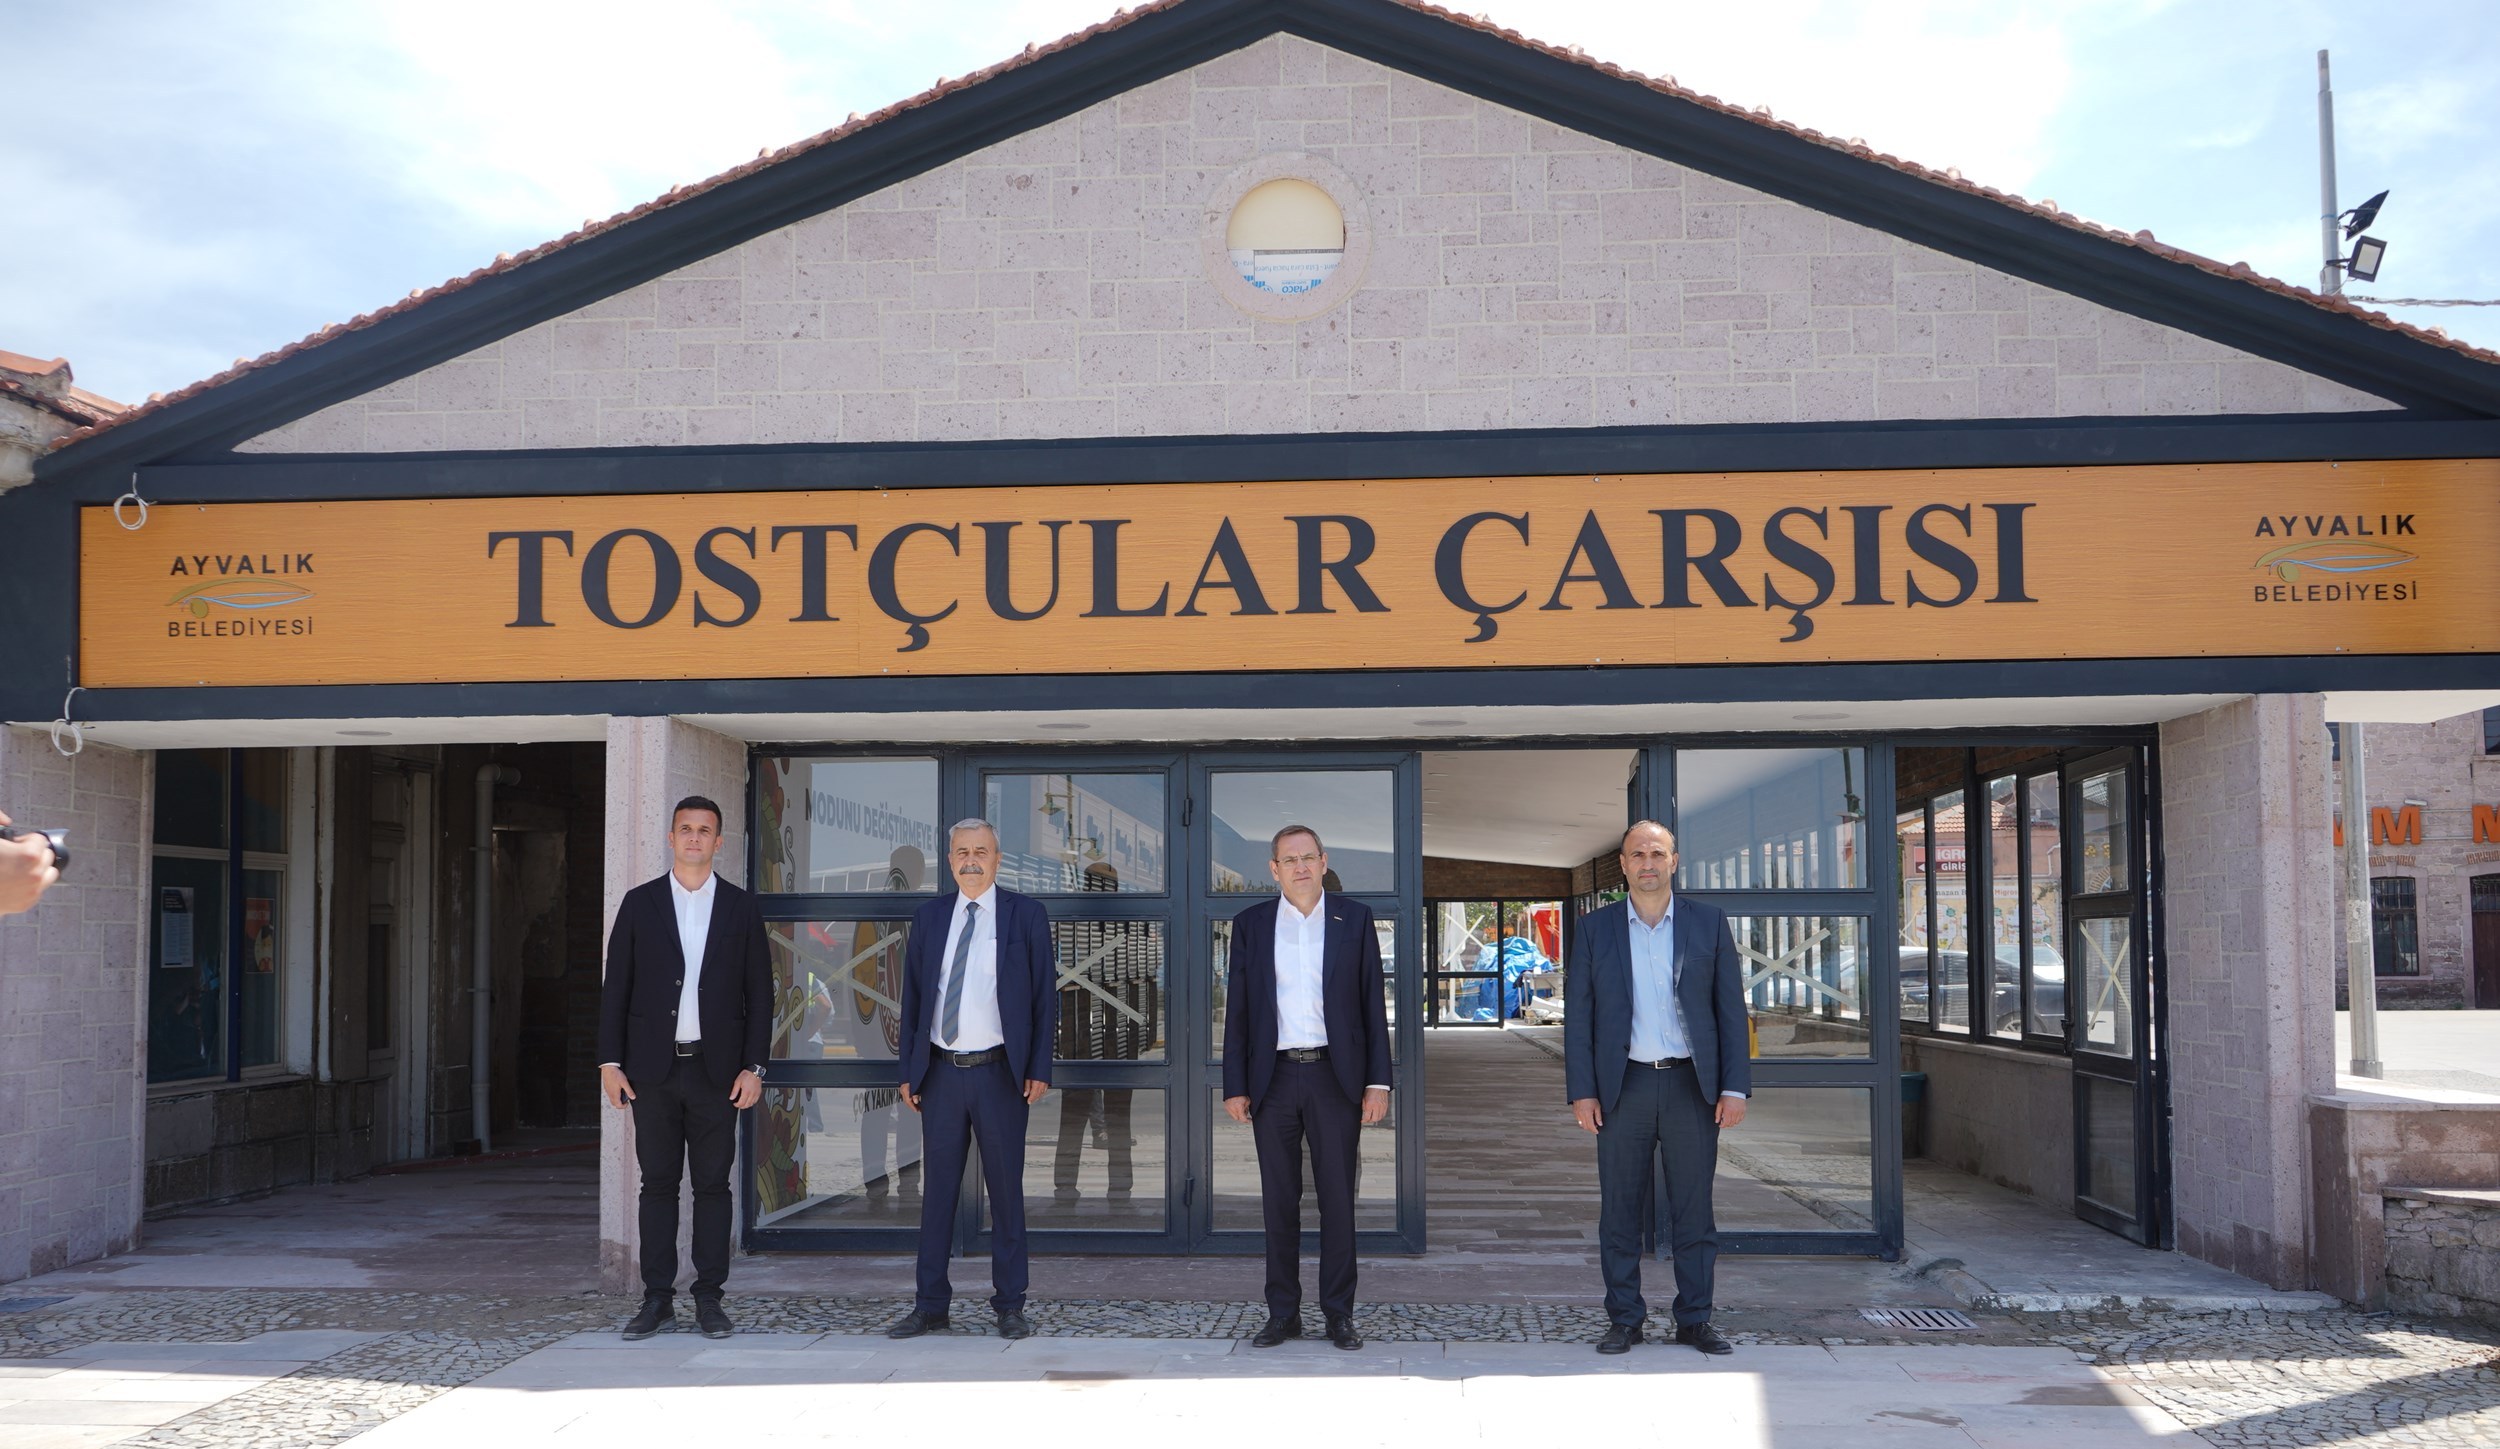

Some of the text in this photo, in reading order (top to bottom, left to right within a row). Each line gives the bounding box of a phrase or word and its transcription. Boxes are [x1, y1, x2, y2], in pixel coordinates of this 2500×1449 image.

[2255, 514, 2416, 537] AYVALIK
[170, 553, 314, 576] AYVALIK
[488, 503, 2039, 652] TOSTÇULAR ÇARŞISI
[2254, 580, 2417, 602] BELEDİYESİ
[168, 616, 313, 637] BELEDİYESİ
[805, 788, 861, 834] MODUNU
[863, 801, 932, 851] DEĞİŞTİRMEYE
